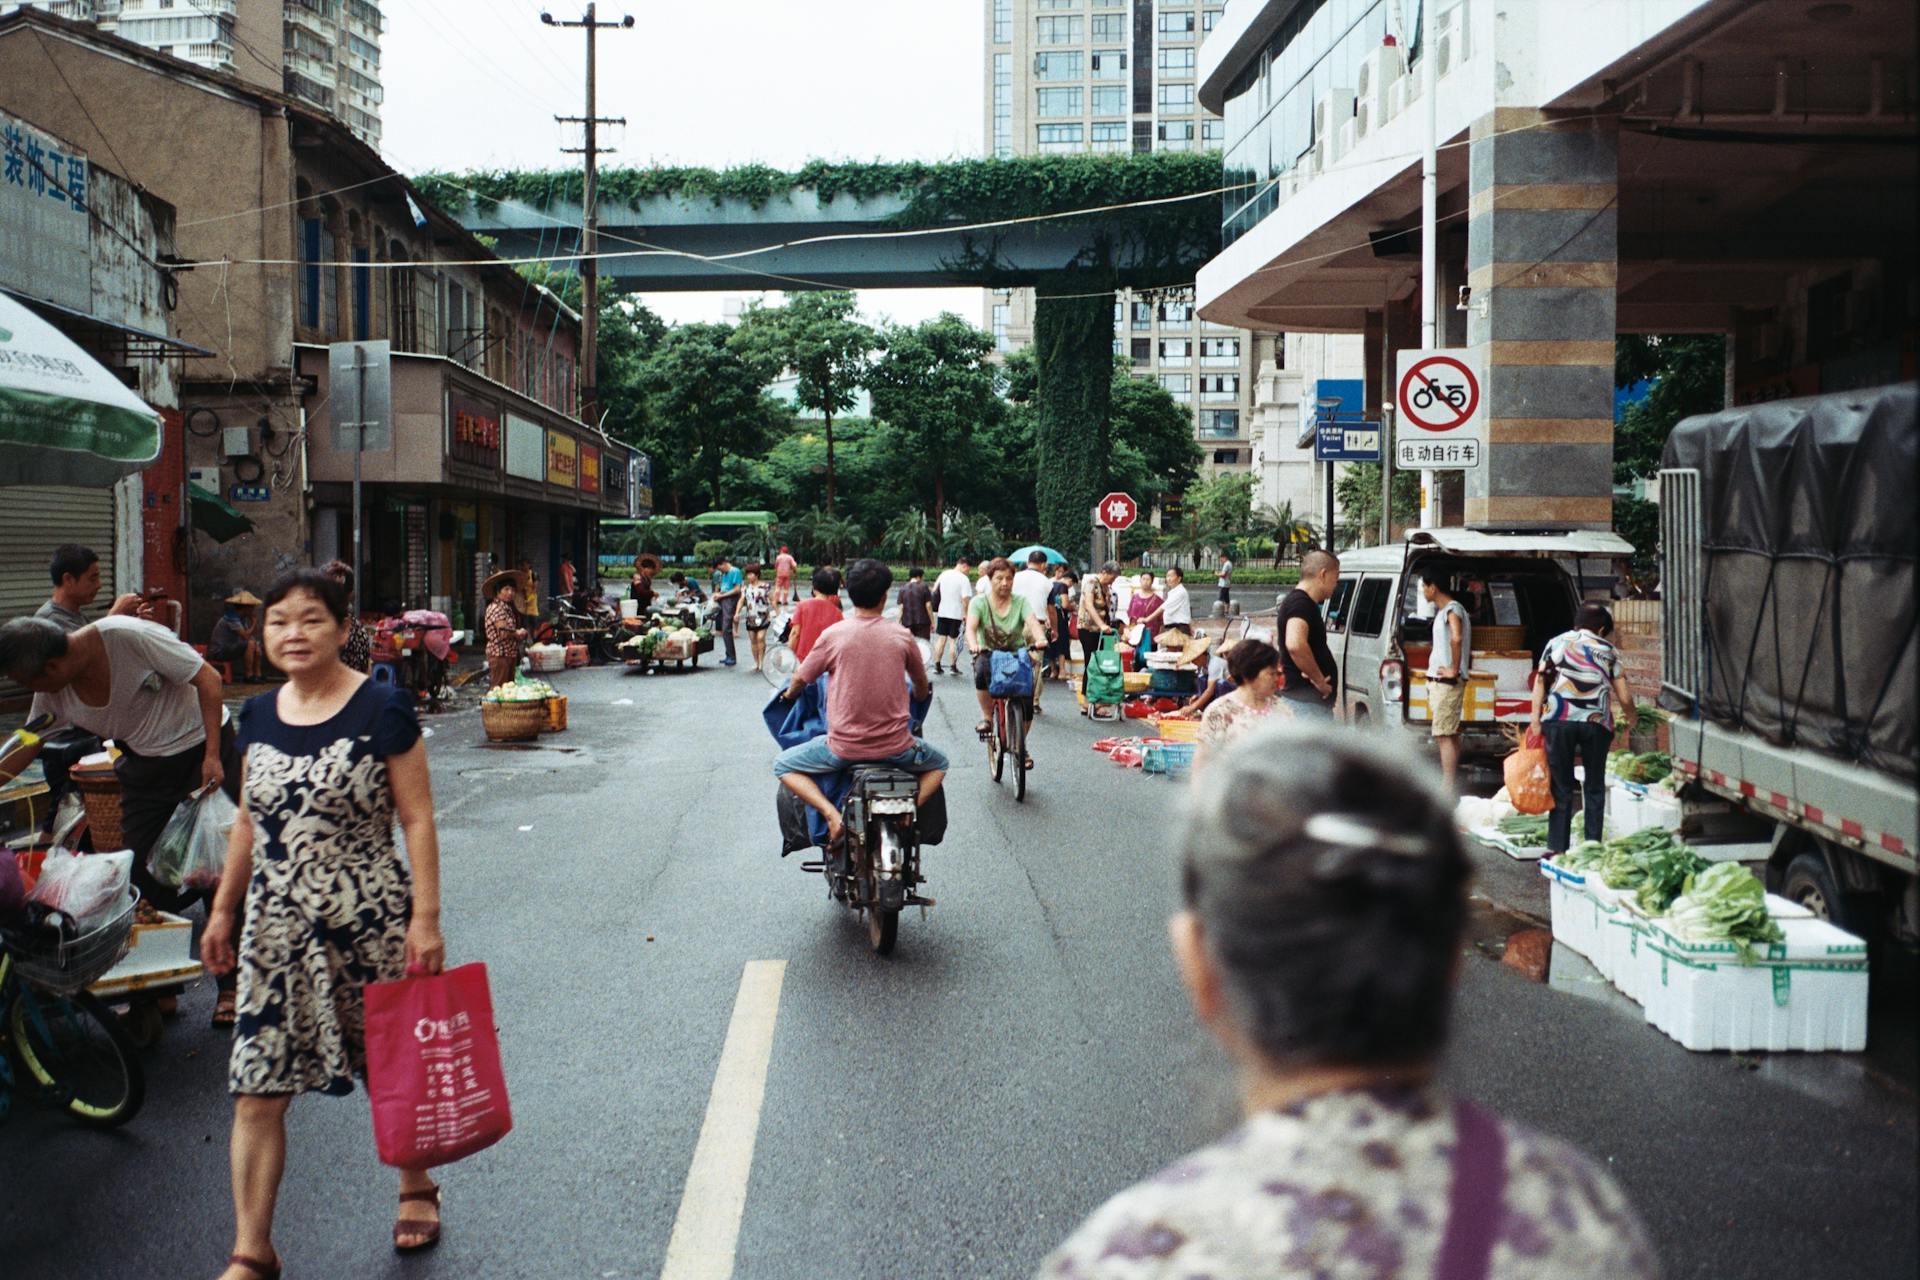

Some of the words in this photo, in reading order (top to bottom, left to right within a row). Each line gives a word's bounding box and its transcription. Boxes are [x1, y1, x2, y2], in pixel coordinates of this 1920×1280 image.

[5, 125, 86, 213] 装饰工程
[1402, 445, 1475, 462] 电动自行车
[1106, 500, 1129, 523] 停
